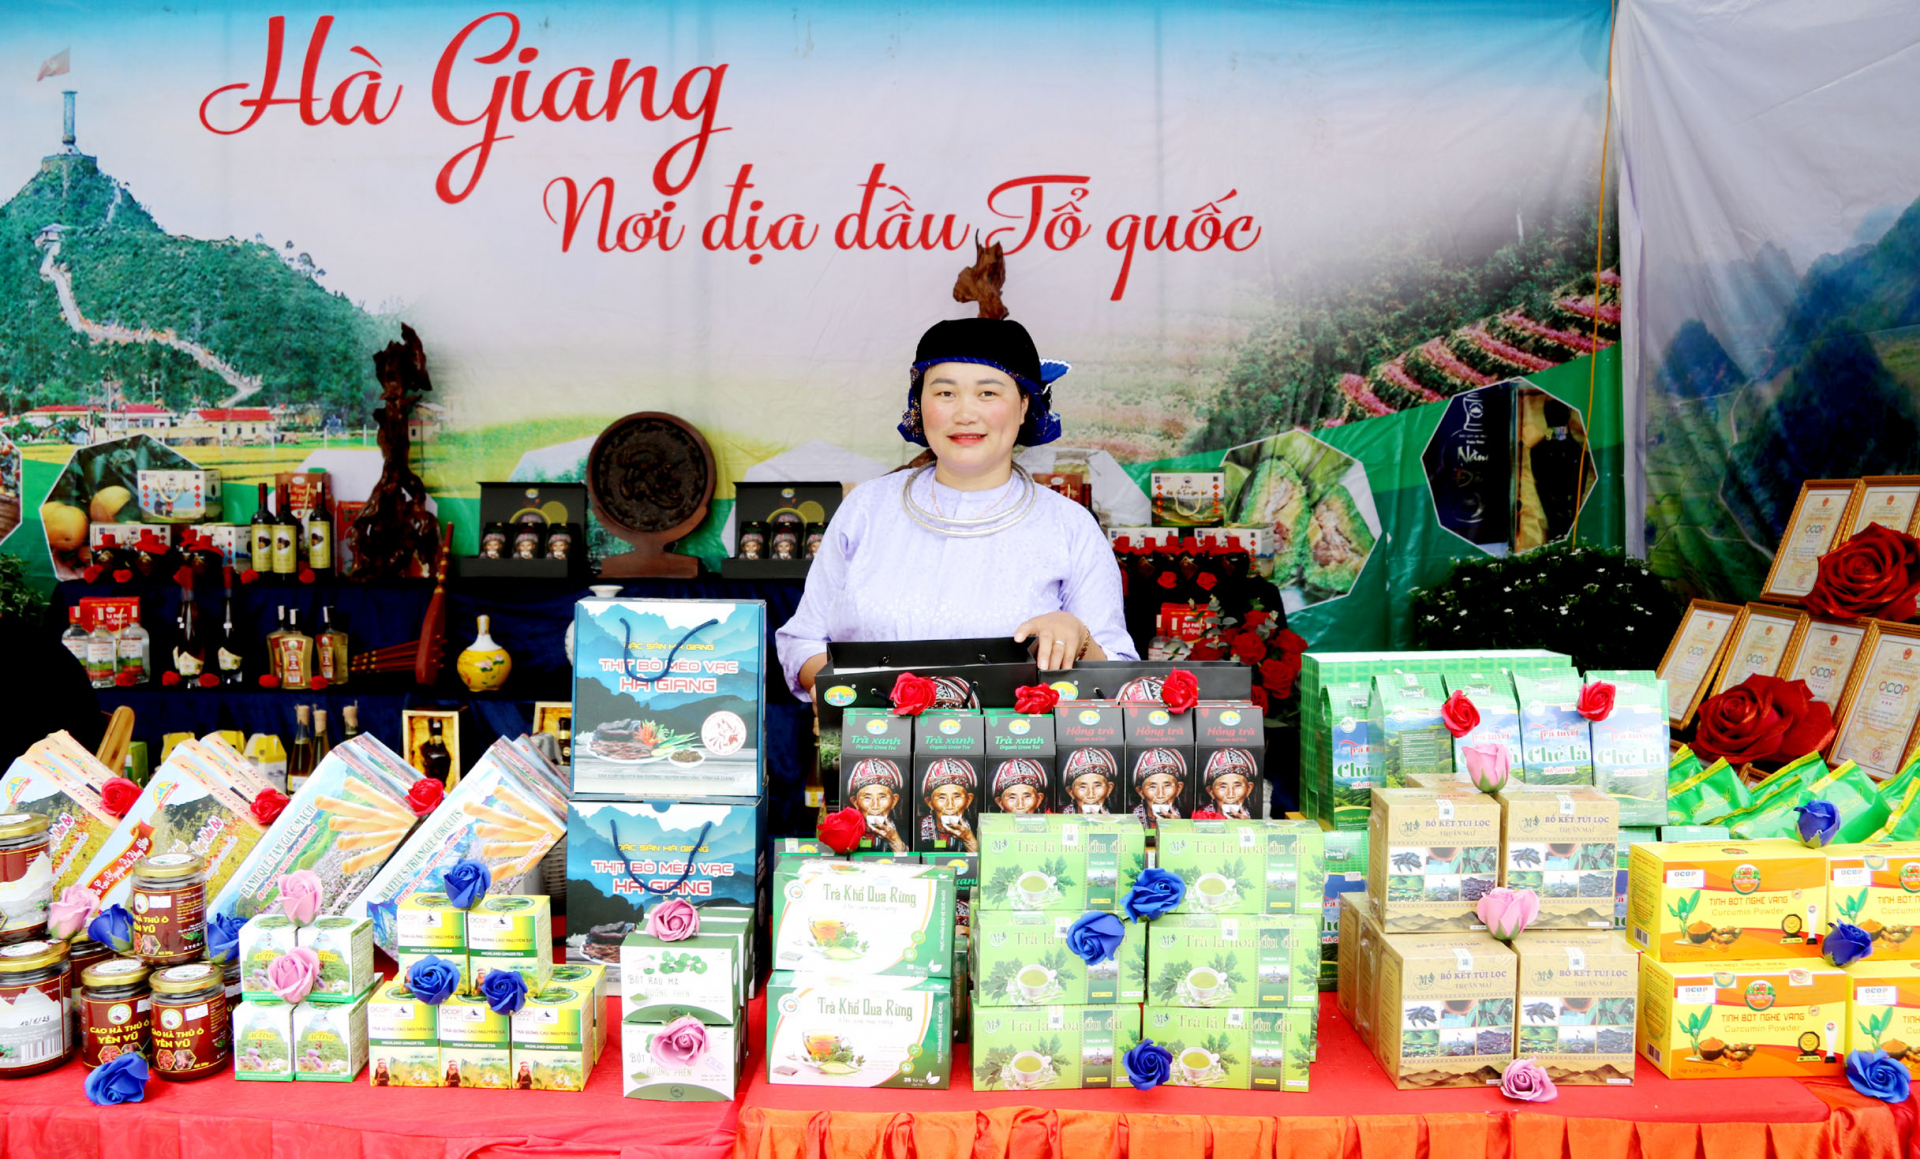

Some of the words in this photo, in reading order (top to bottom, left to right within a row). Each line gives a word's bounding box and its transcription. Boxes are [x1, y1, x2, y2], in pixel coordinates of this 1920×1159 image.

[199, 15, 402, 135] Hà
[431, 11, 733, 204] Giang
[543, 176, 684, 253] Nơi
[702, 163, 819, 265] địa
[834, 163, 970, 251] đầu
[985, 174, 1091, 255] Tổ
[1105, 188, 1261, 301] quốc
[636, 658, 661, 672] BÒ
[704, 661, 738, 675] VẠC
[1810, 666, 1836, 680] OCOP
[655, 677, 716, 693] GIANG
[1879, 681, 1910, 695] OCOP
[1066, 726, 1094, 737] Hồng
[1097, 727, 1114, 735] trà
[1135, 726, 1163, 737] Hồng
[1166, 727, 1184, 735] trà
[1207, 727, 1234, 737] Hồng
[1237, 727, 1255, 736] trà
[851, 735, 869, 745] Trà
[872, 735, 901, 745] xanh
[924, 735, 943, 744] Trà
[945, 736, 975, 745] xanh
[995, 736, 1013, 744] Trà
[1015, 736, 1045, 745] xanh
[1554, 766, 1575, 774] GIANG
[1474, 820, 1491, 829] LỌC
[405, 838, 437, 872] TRIANGLE
[433, 809, 463, 841] CIRCUITS
[1014, 839, 1038, 853] Trà
[268, 843, 286, 862] TAM
[592, 861, 626, 875] THỊT
[699, 863, 734, 878] VẠC
[823, 883, 841, 901] Trà
[843, 882, 865, 901] Khổ
[890, 885, 917, 908] Rừng
[1712, 908, 1751, 916] Curcumin
[1014, 932, 1038, 945] Trà
[1184, 934, 1207, 948] Trà
[818, 997, 836, 1014] Trà
[838, 998, 860, 1014] Khổ
[886, 998, 913, 1021] Rừng
[1007, 1019, 1033, 1032] Trà
[1177, 1014, 1201, 1028] Trà
[90, 1026, 107, 1034] CAO
[109, 1024, 123, 1033] HÀ
[163, 1030, 174, 1038] HÀ
[1724, 1025, 1765, 1033] Curcumin
[1768, 1024, 1800, 1032] Powder
[98, 1034, 121, 1044] YÊN
[123, 1031, 139, 1041] VŨ
[155, 1038, 173, 1048] YÊN
[175, 1038, 191, 1047] VŨ
